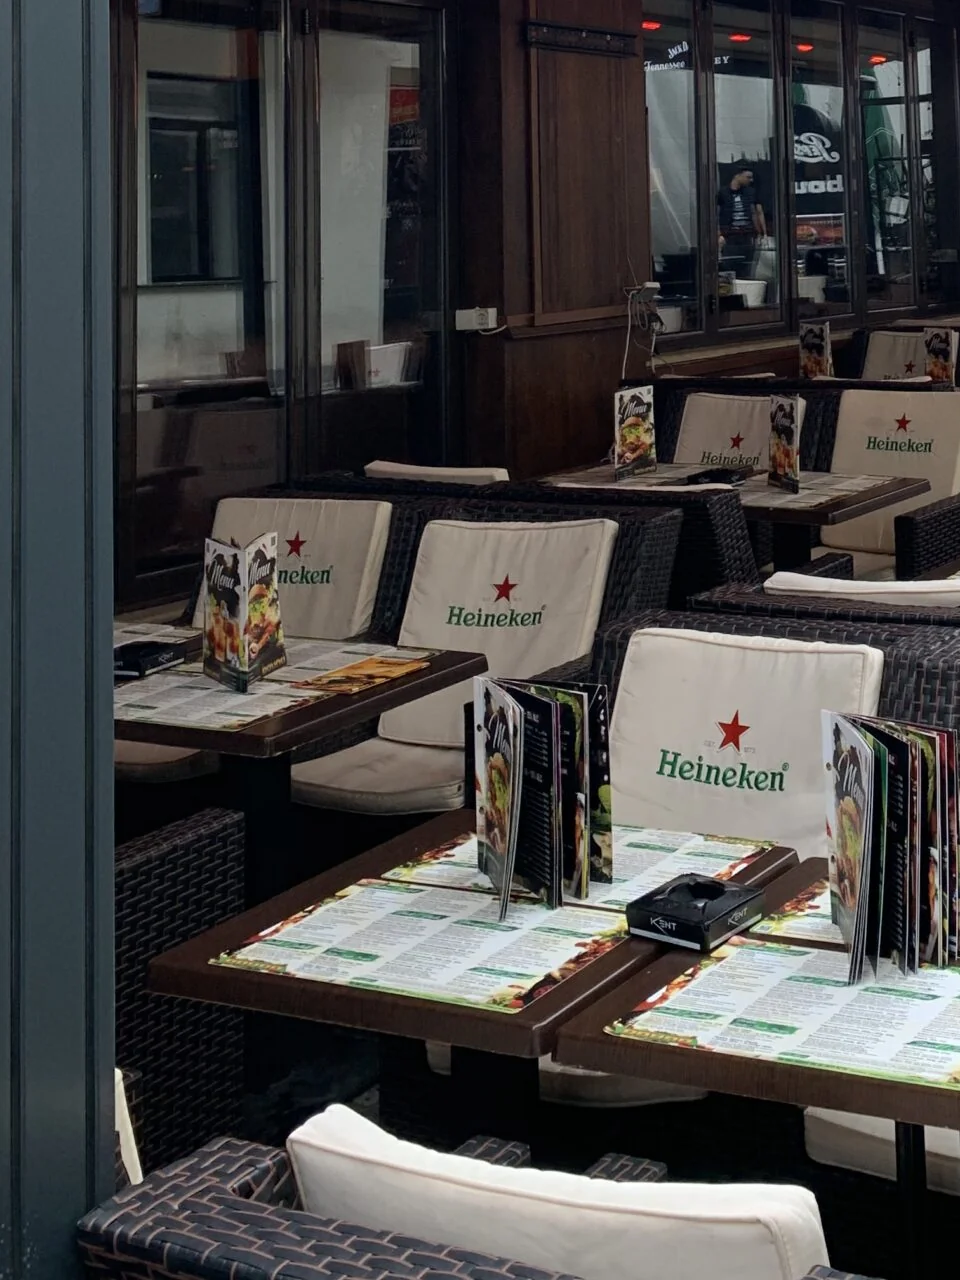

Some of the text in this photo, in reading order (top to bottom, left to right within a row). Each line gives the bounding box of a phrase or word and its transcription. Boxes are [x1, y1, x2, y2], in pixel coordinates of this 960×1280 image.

[644, 61, 685, 72] Tennessee
[623, 402, 648, 420] Menu
[866, 435, 933, 453] Heineken
[700, 451, 760, 467] Heineken
[210, 559, 235, 591] Menu
[278, 565, 332, 584] neken
[445, 606, 542, 628] Heineken
[656, 748, 786, 792] Heineken
[650, 916, 677, 935] KENT
